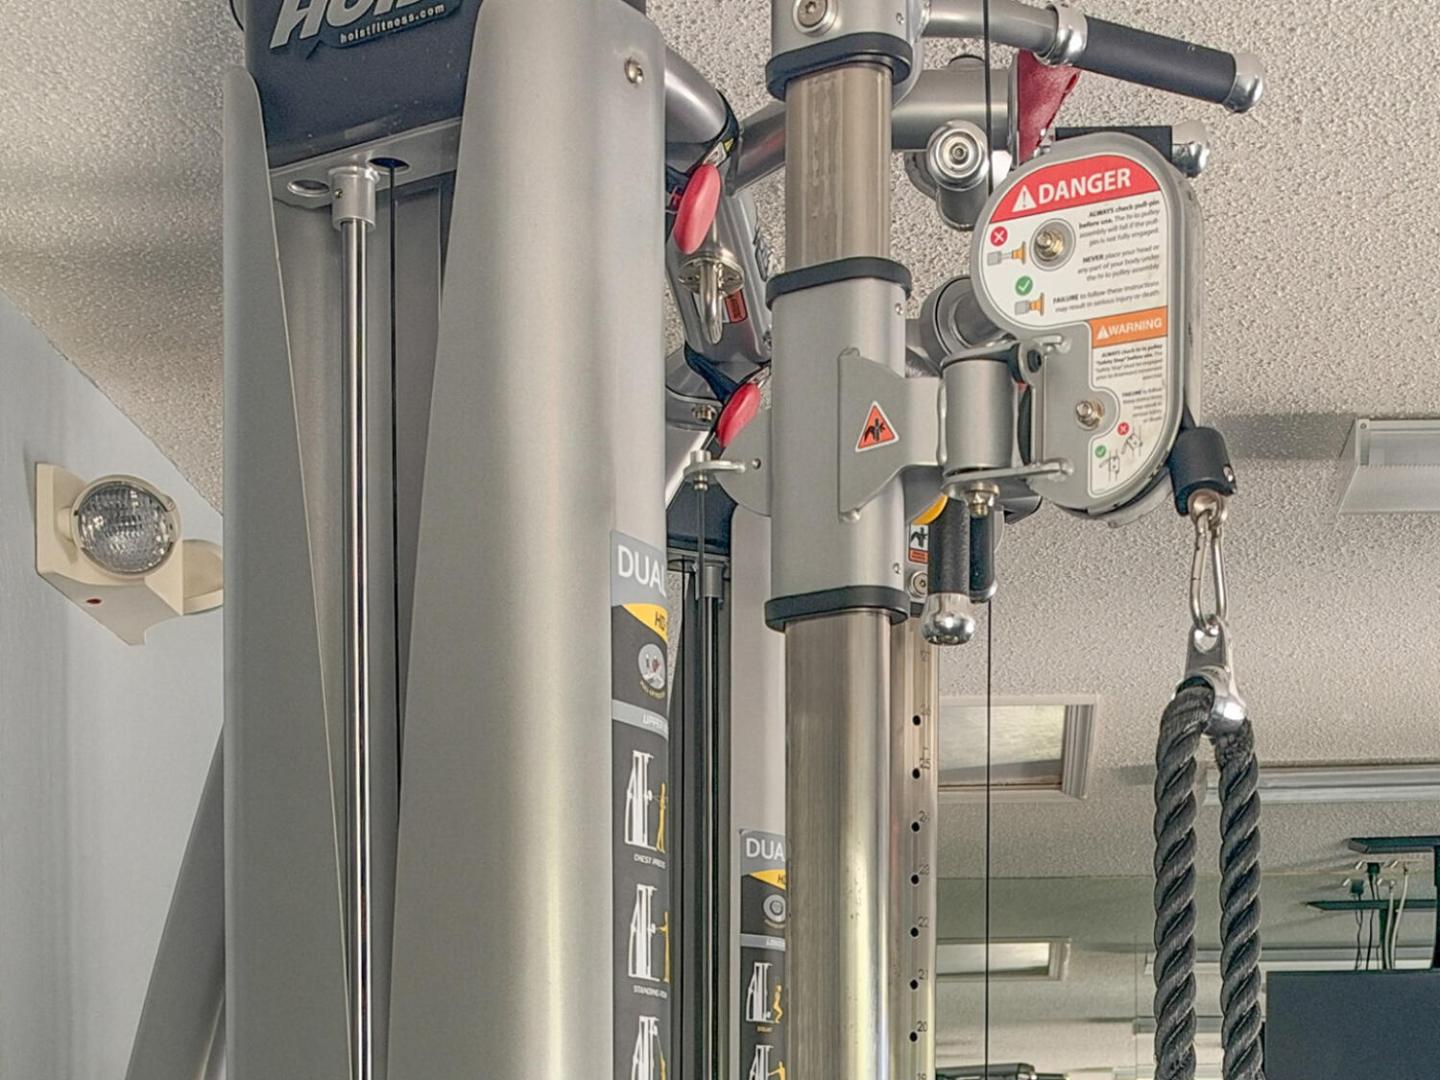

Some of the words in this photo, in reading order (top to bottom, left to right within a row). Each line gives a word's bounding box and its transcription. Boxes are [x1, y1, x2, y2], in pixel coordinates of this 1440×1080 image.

[1039, 168, 1131, 205] DANGER
[1108, 318, 1162, 336] WARNING
[746, 837, 785, 862] DUA
[917, 1021, 928, 1032] 20
